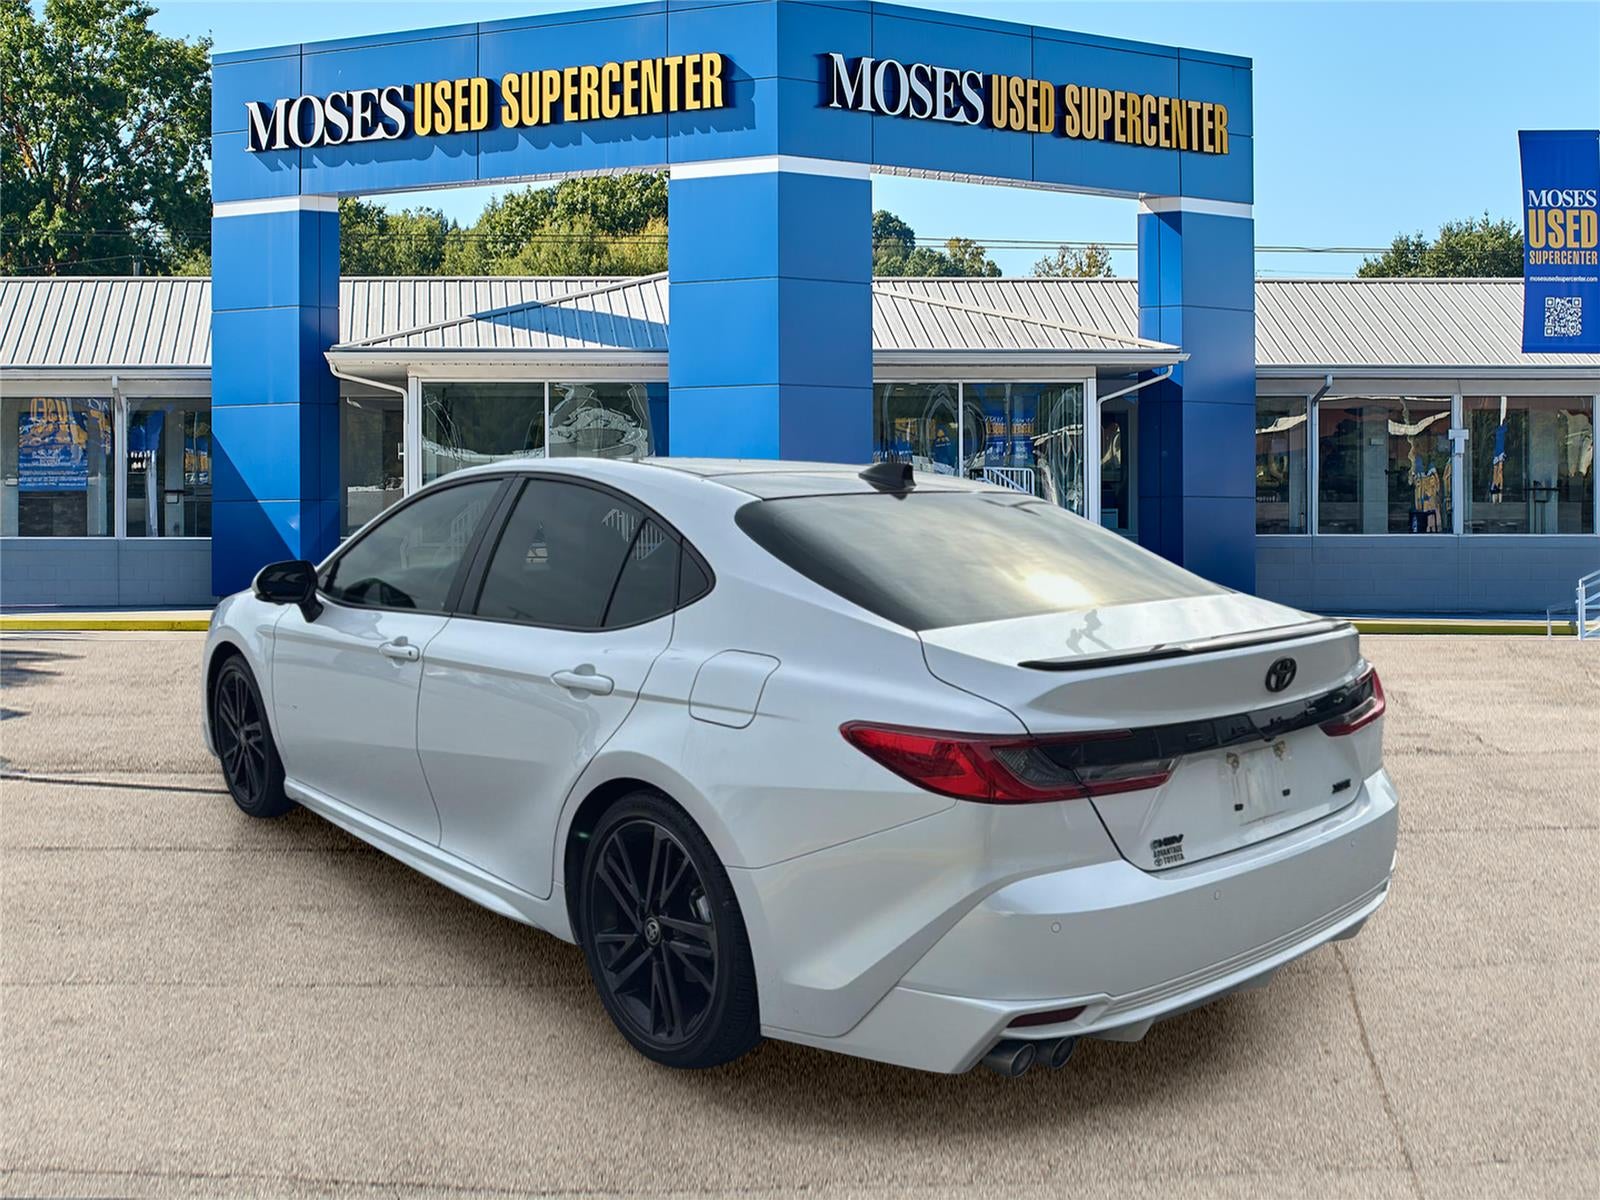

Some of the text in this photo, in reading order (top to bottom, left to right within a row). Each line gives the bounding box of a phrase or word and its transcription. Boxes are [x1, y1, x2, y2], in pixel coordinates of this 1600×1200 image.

[245, 52, 724, 152] MOSES USED SUPERCENTER
[829, 52, 1229, 154] MOSES USED SUPERCENTER
[1527, 189, 1597, 207] MOSES
[1528, 209, 1598, 248] USED
[1529, 250, 1598, 265] SUPERCENTER
